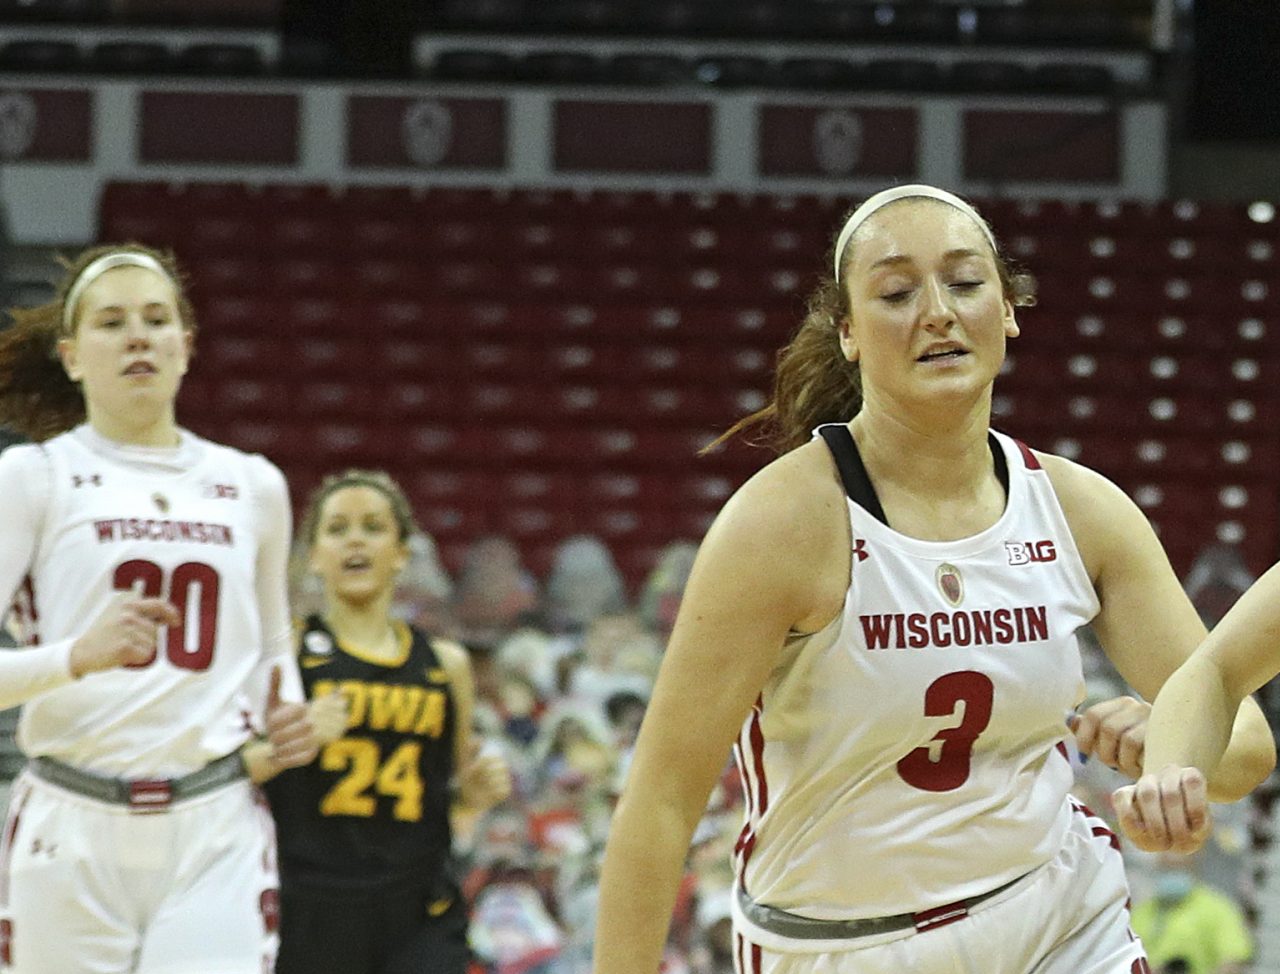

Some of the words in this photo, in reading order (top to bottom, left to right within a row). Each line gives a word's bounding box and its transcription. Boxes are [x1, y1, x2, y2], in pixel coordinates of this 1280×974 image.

[94, 518, 233, 545] WISCONSIN
[860, 606, 1048, 650] WISCONSIN
[313, 680, 447, 739] OWA
[897, 670, 994, 792] 3
[319, 738, 425, 822] 24
